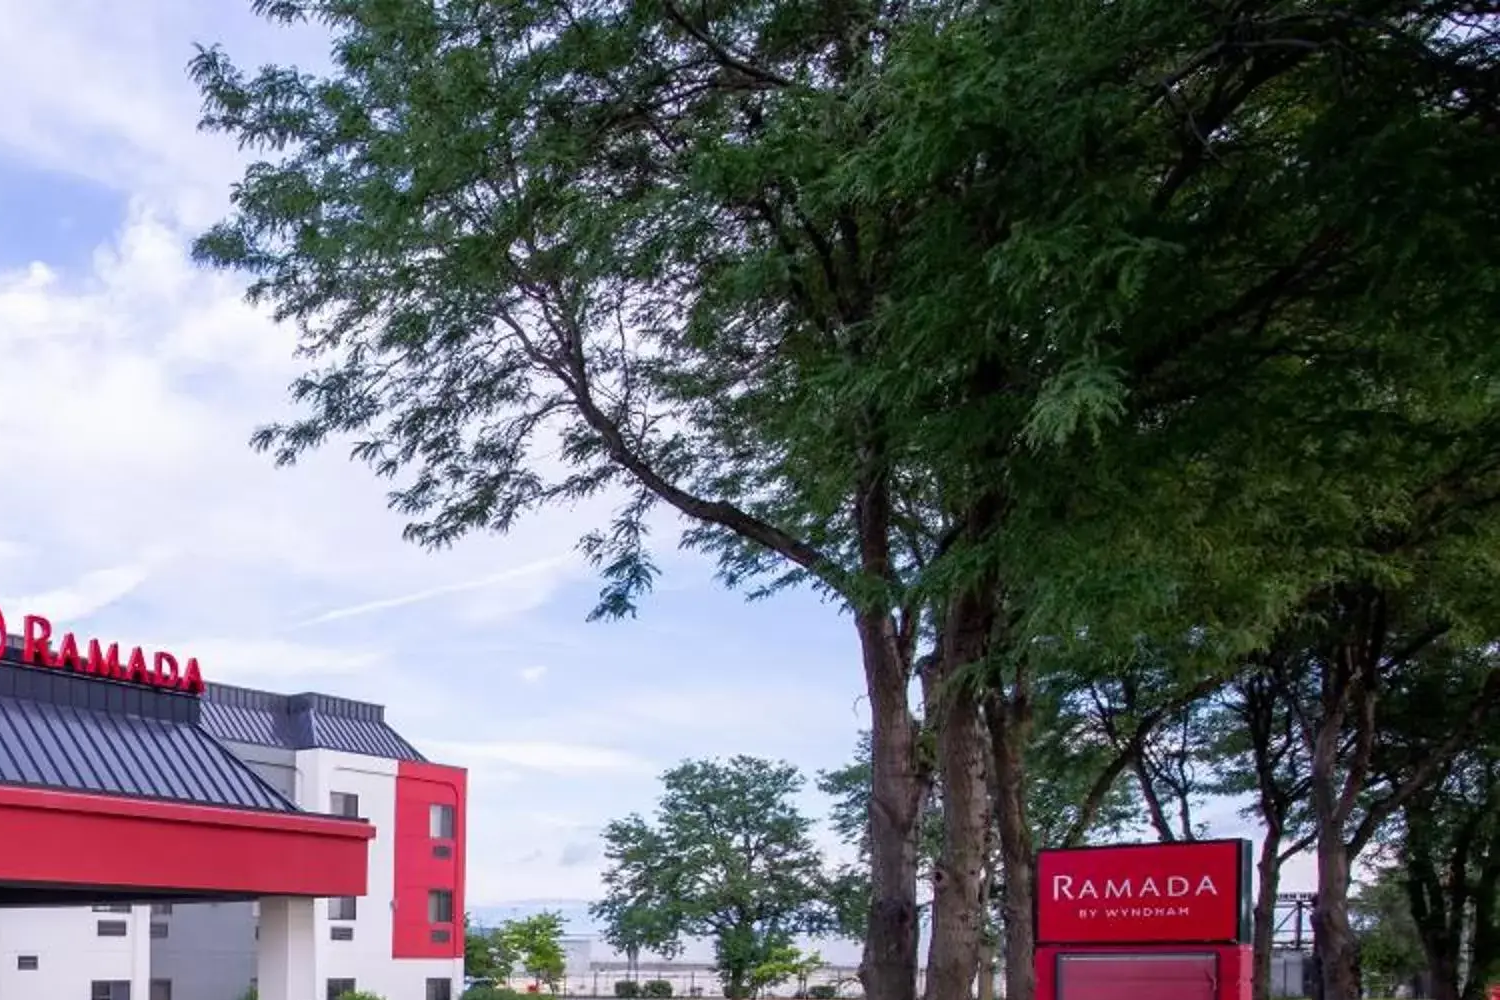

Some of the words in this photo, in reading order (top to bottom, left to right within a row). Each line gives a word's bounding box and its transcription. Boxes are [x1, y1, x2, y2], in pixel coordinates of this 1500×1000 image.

[23, 614, 206, 694] RAMADA
[1052, 875, 1218, 901] RAMADA
[1079, 909, 1098, 919] BY
[1105, 906, 1190, 919] WYNDHAM
